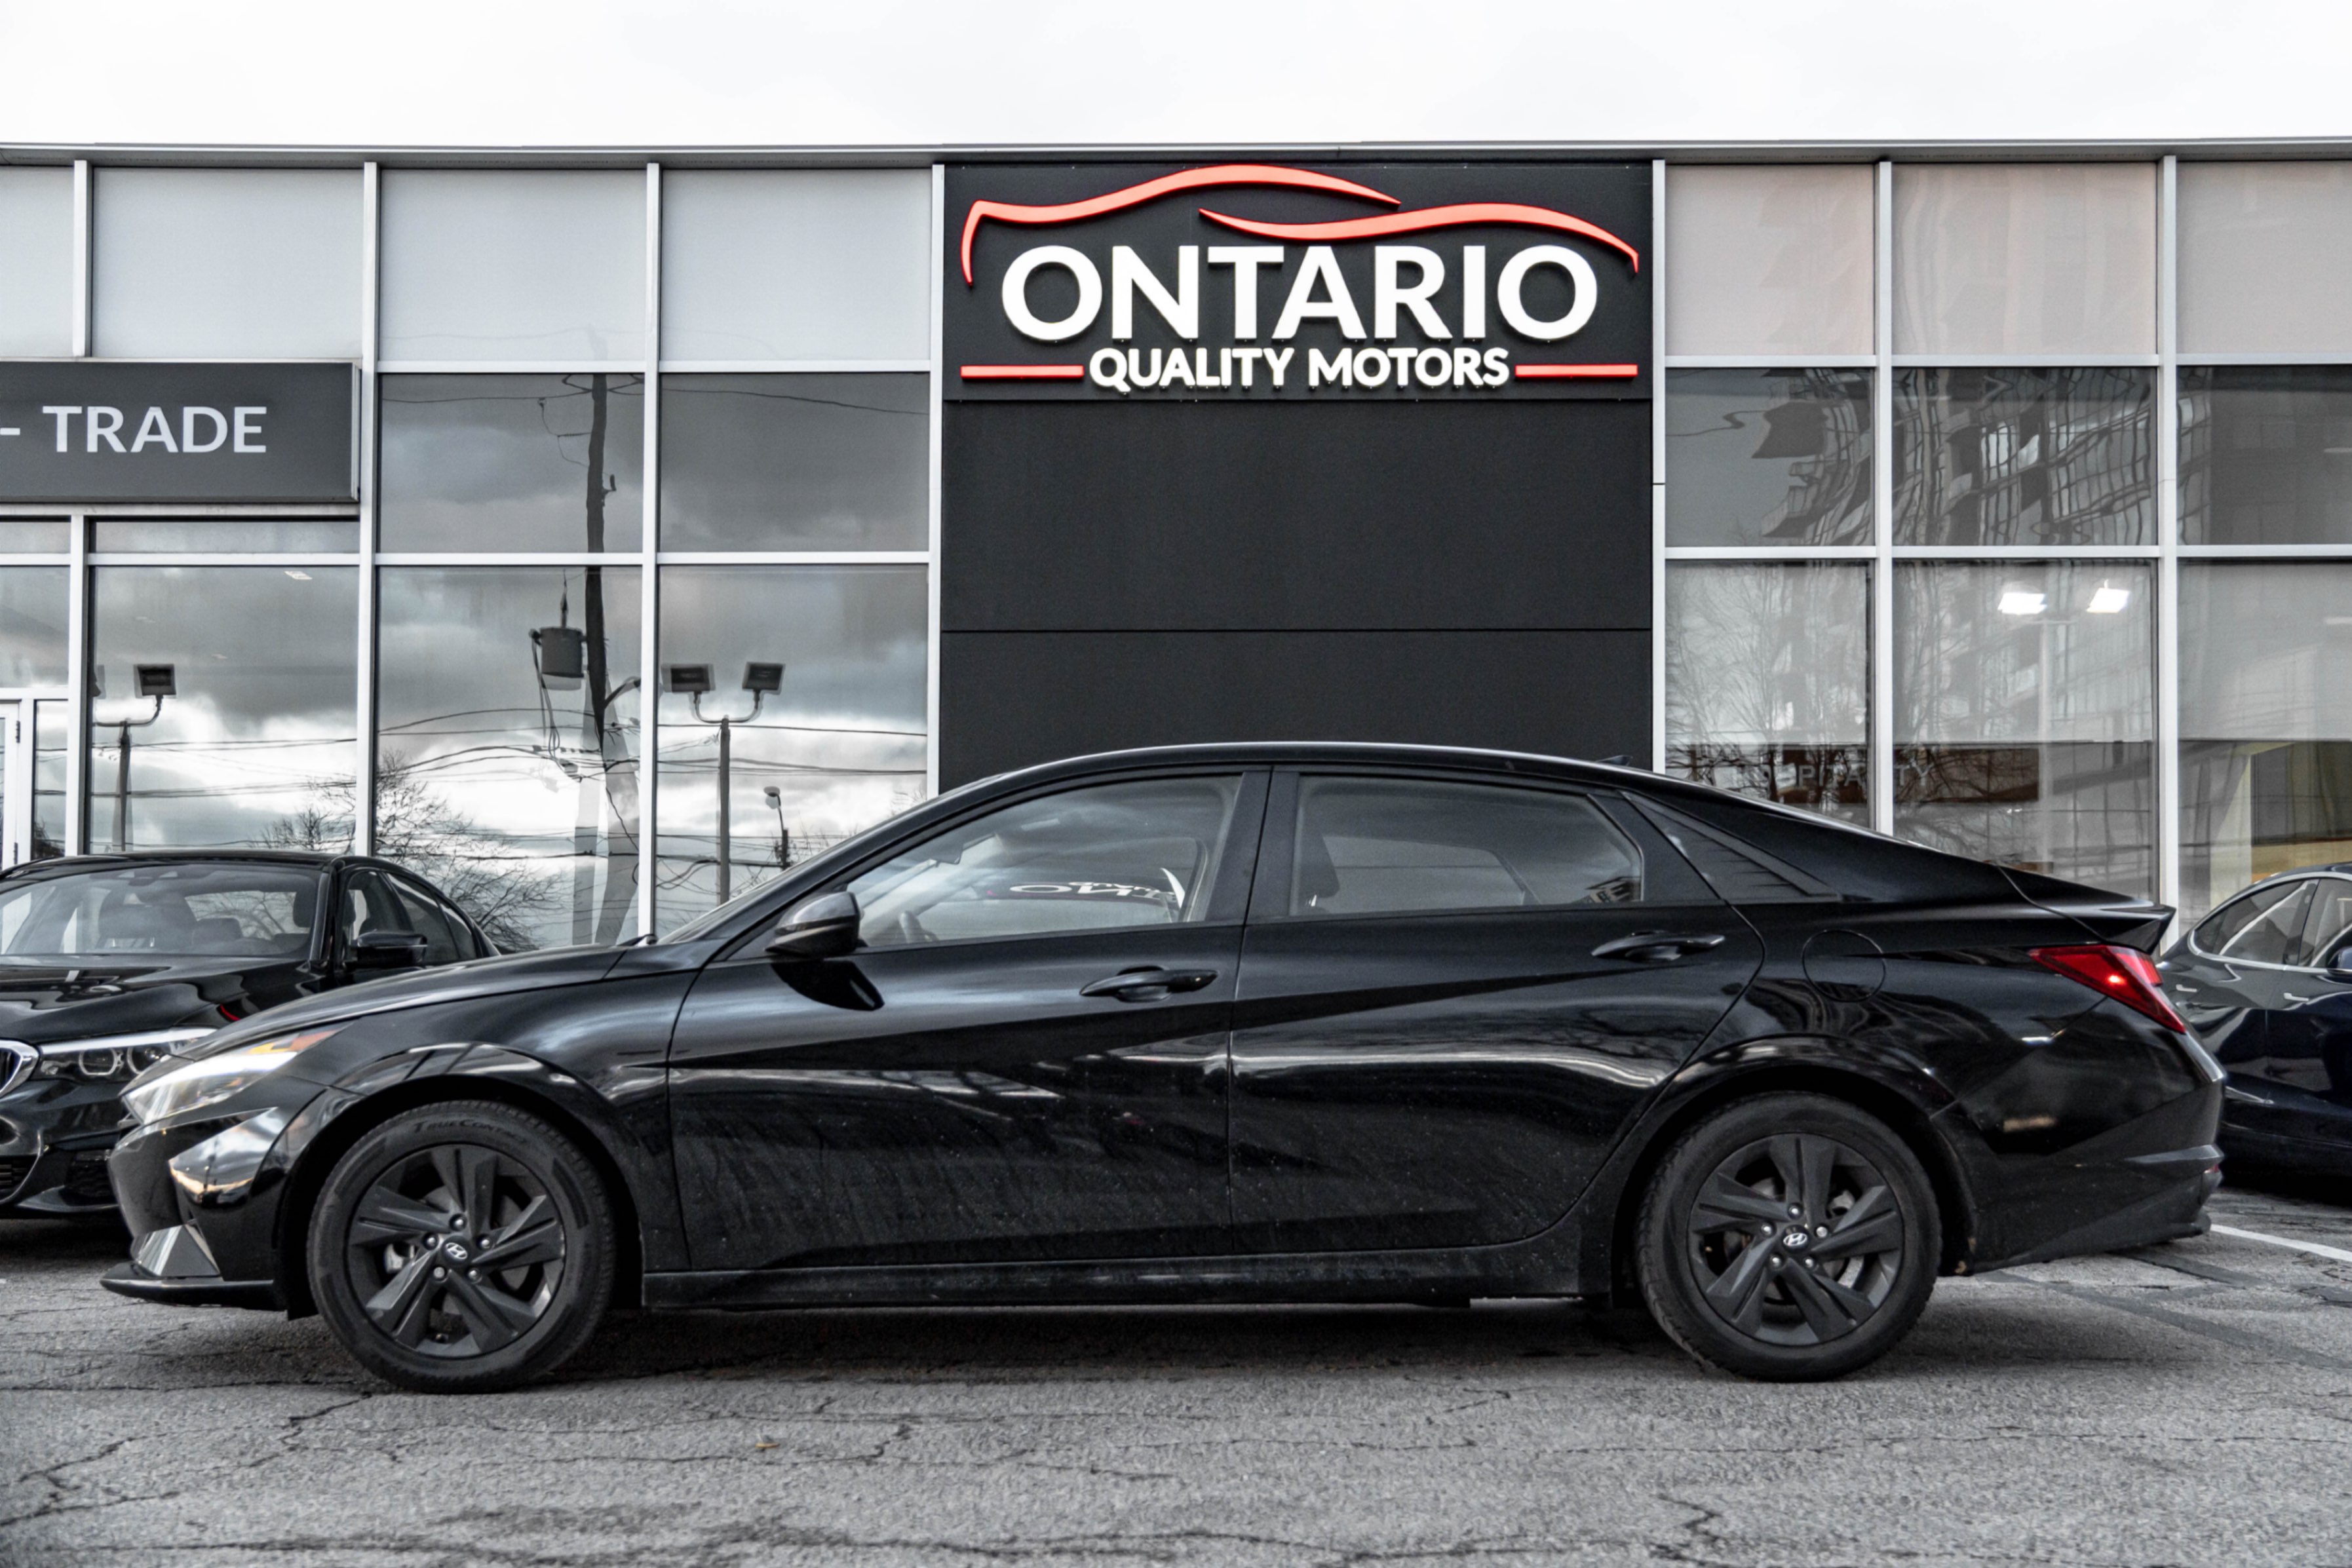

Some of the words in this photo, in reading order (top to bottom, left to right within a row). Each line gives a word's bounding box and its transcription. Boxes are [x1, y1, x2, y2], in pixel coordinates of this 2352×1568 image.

[1002, 244, 1597, 339] ONTARIO
[1089, 347, 1295, 392] QUALITY
[1309, 347, 1509, 387] MOTORS
[42, 406, 267, 453] TRADE
